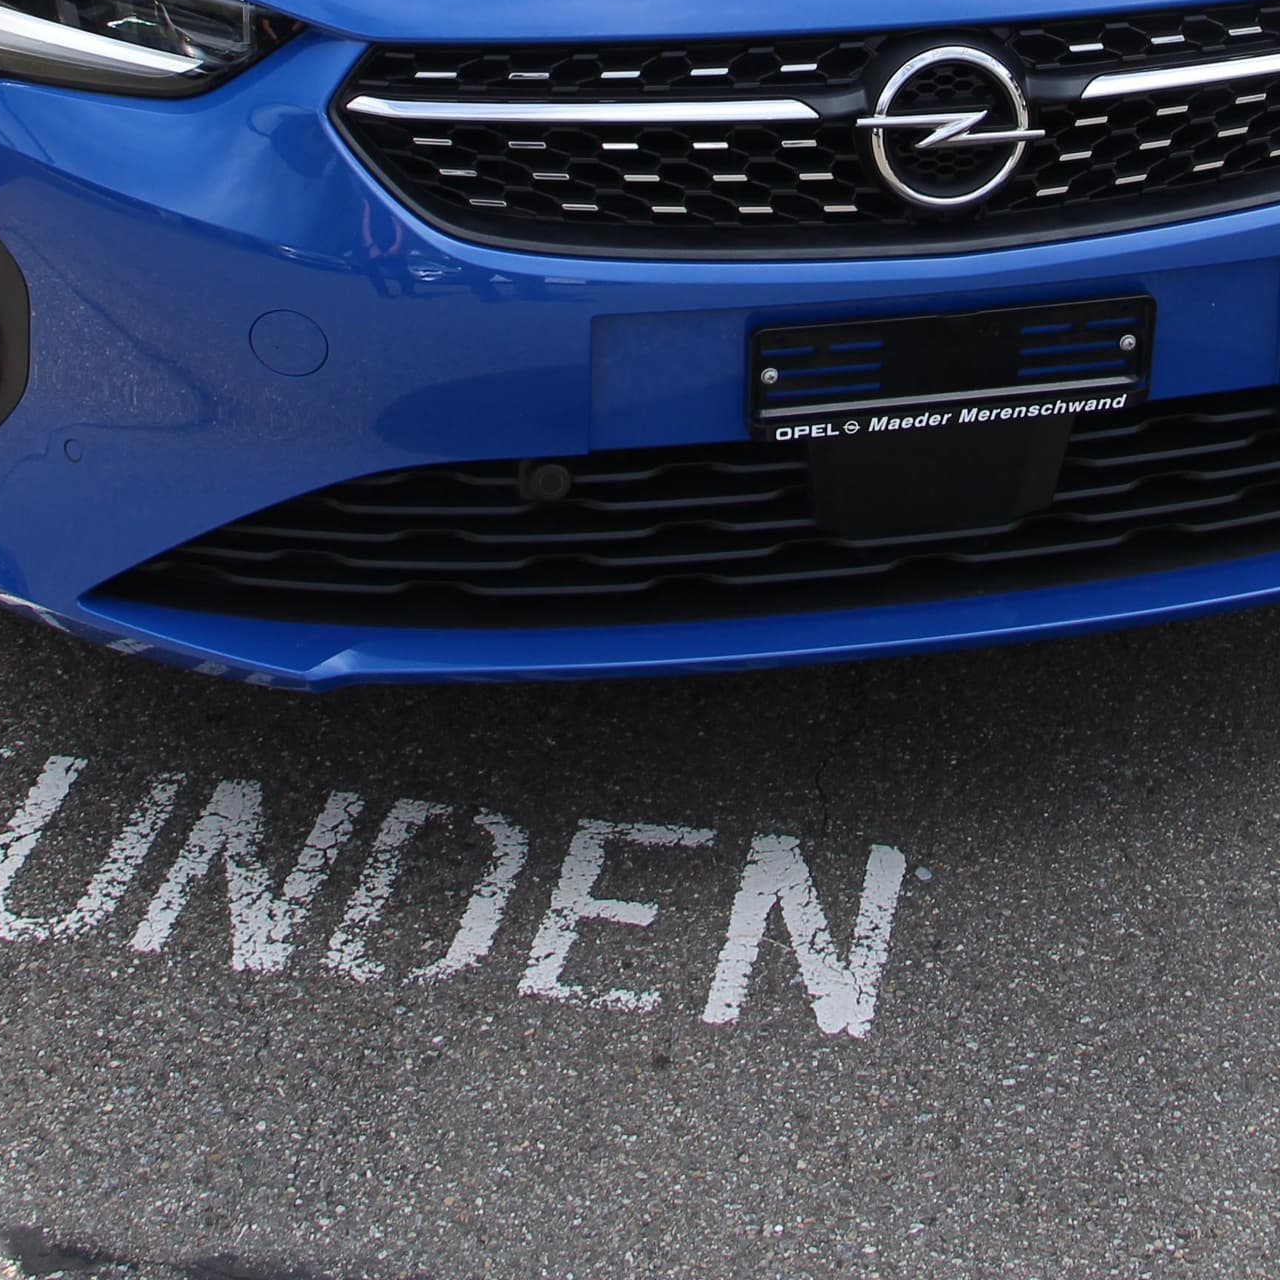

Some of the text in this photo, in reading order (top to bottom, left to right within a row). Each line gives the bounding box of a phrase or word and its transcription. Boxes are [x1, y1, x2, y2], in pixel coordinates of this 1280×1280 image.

[775, 393, 1128, 441] OPEL Maeder Merenschwand
